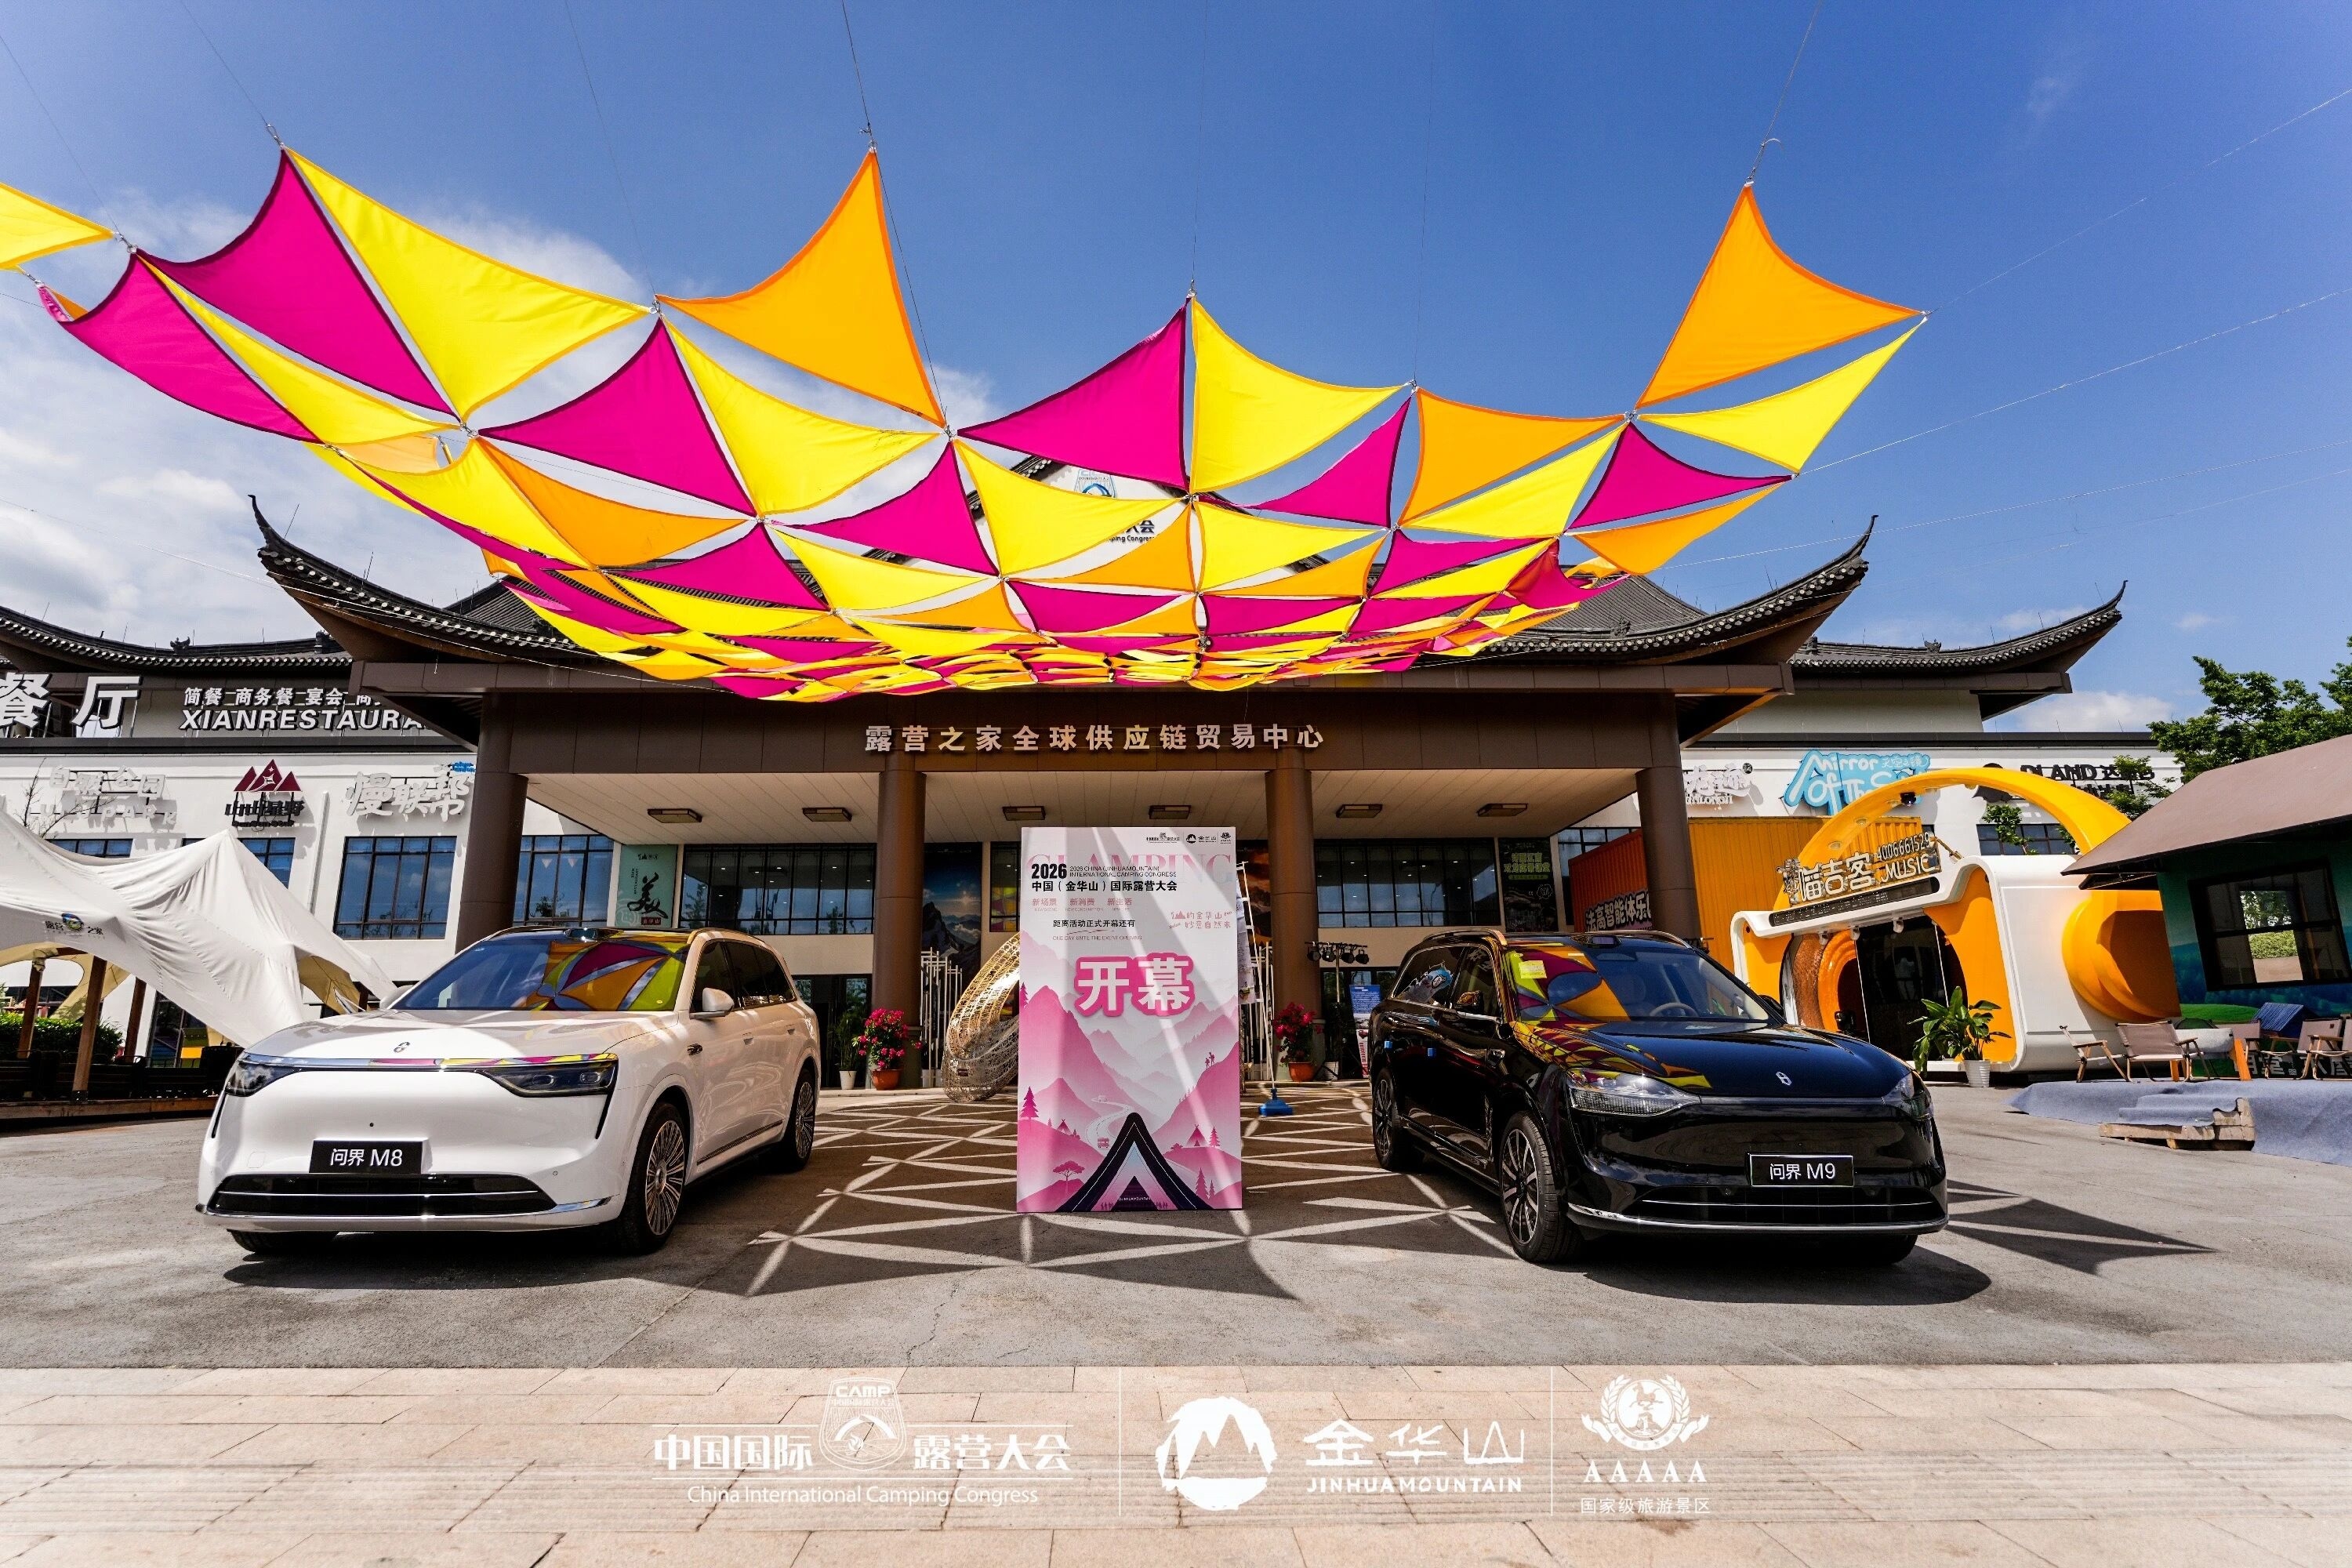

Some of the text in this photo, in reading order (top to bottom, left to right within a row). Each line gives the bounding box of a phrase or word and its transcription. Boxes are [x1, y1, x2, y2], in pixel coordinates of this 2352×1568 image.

[0, 672, 140, 728] 餐厅
[183, 687, 221, 706] 简餐
[234, 687, 292, 706] 商务餐
[305, 688, 343, 706] 宴会
[864, 723, 1325, 753] 露营之家全球供应链贸易中心
[1881, 757, 1929, 768] 天空之镜
[1876, 832, 1932, 861] 4006661529
[1031, 863, 1068, 879] 2026
[1882, 855, 1935, 883] MUSIC
[1069, 898, 1095, 906] 新消费
[1107, 898, 1133, 906] 新生活
[1076, 955, 1192, 1013] 开幕
[329, 1148, 403, 1167] 问界 M8
[1769, 1163, 1836, 1180] 问界 M9
